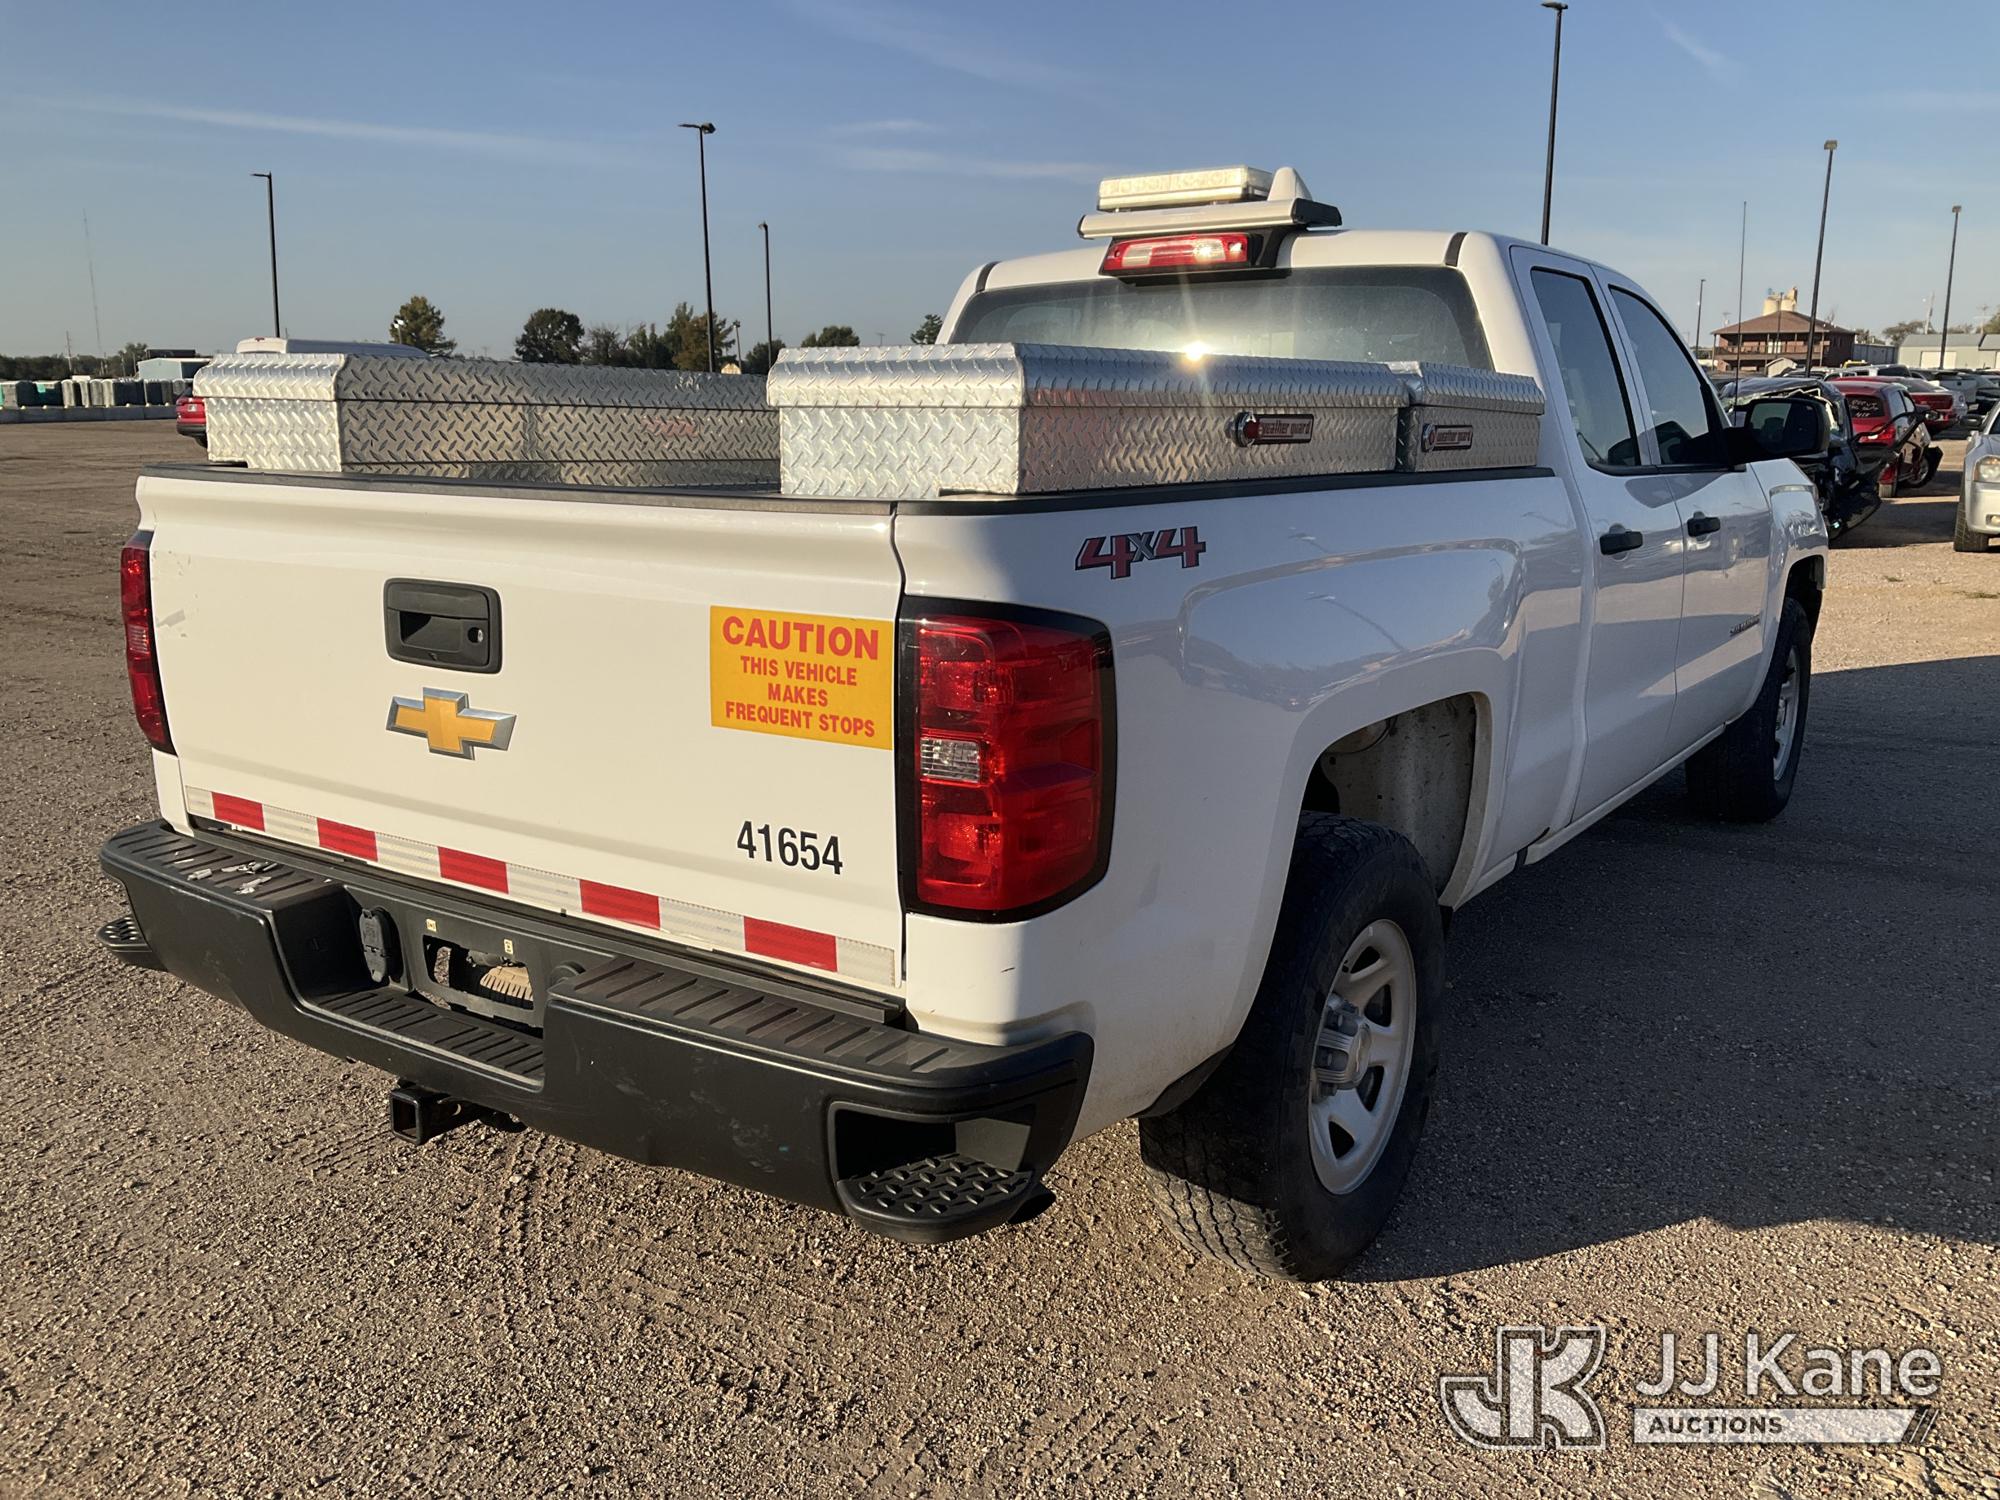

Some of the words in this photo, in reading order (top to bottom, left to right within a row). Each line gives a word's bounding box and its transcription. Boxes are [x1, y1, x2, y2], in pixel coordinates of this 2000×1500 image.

[722, 616, 879, 660] CAUTION
[740, 655, 779, 677] THIS
[784, 660, 857, 687] VEHICLE
[767, 682, 828, 707] MAKES
[725, 701, 813, 729] FREQUENT
[818, 714, 875, 738] STOPS
[737, 820, 843, 875] 41654
